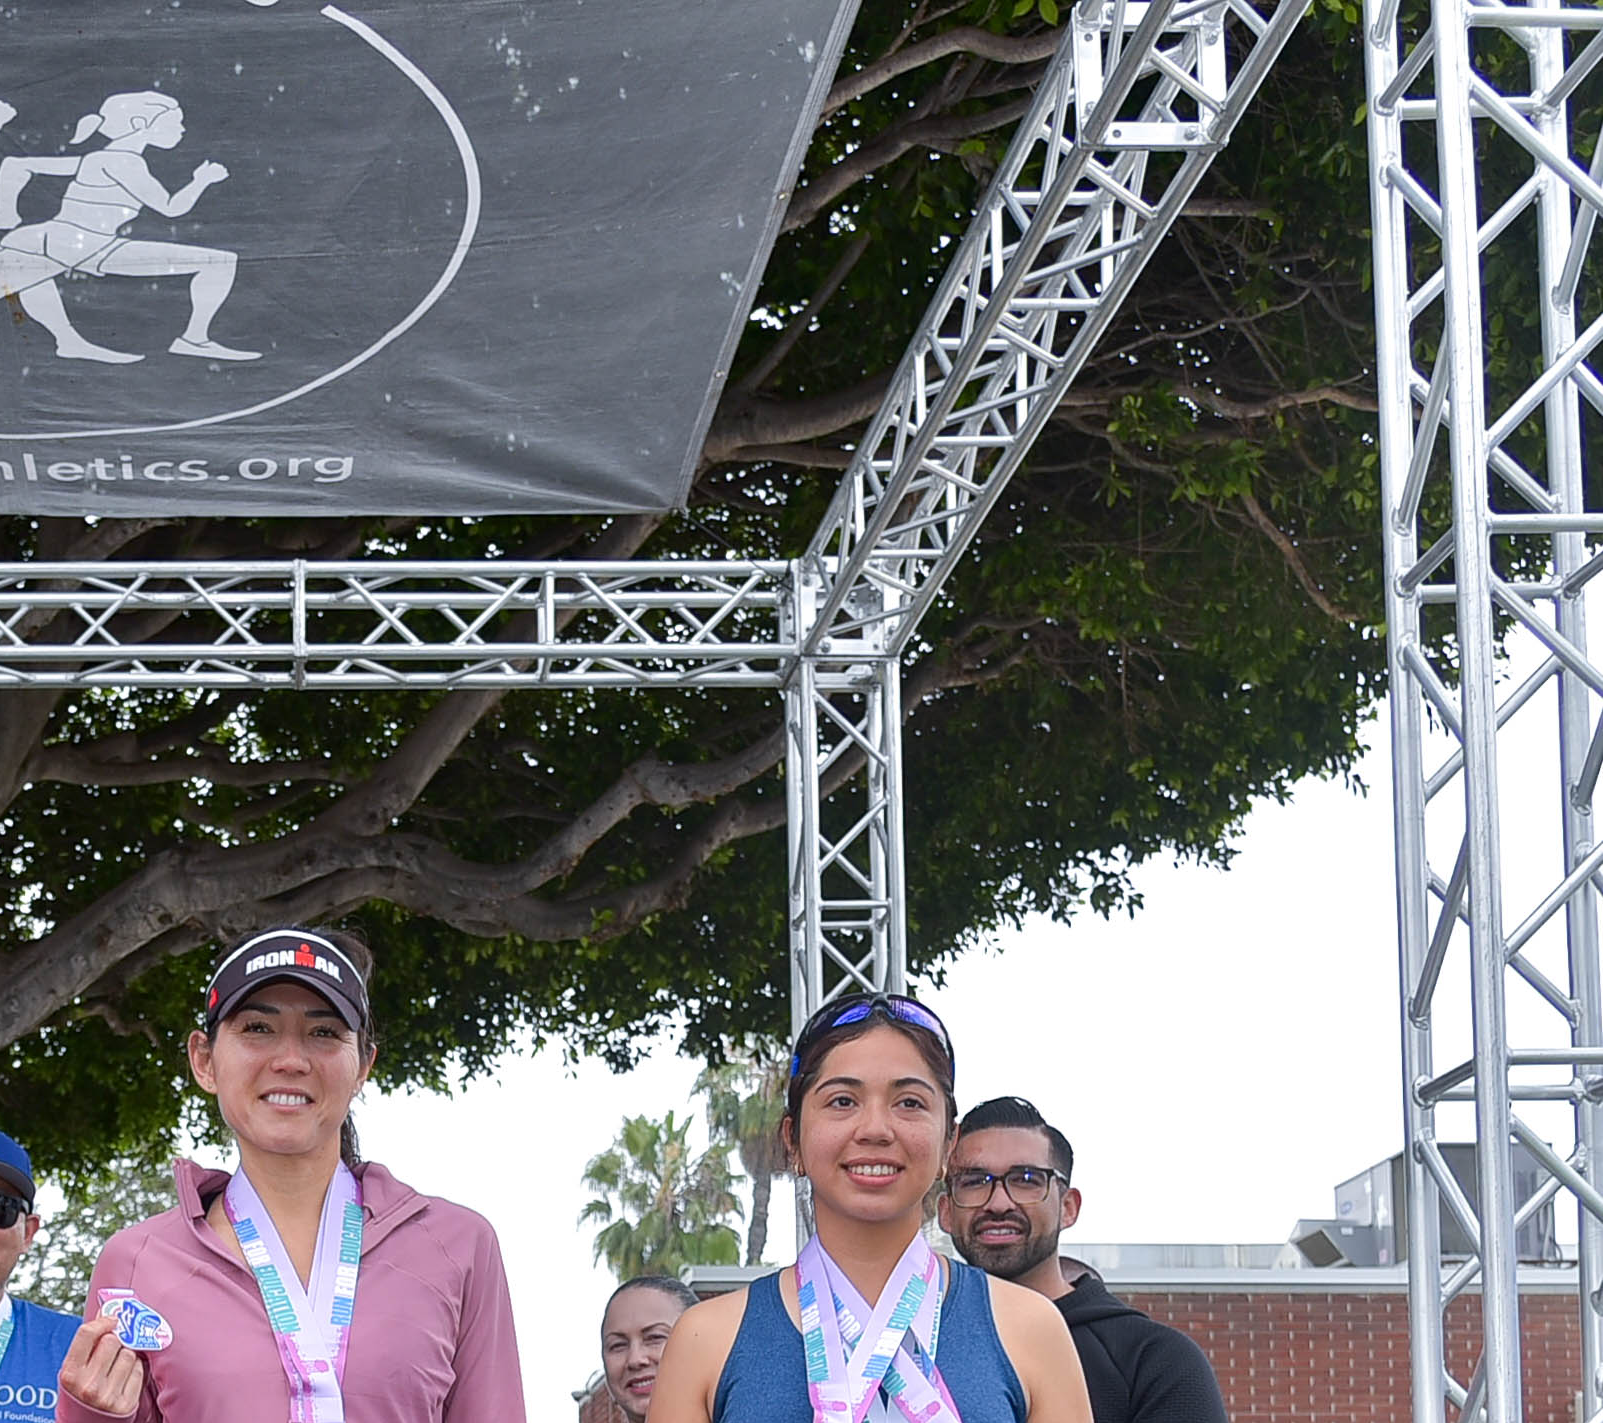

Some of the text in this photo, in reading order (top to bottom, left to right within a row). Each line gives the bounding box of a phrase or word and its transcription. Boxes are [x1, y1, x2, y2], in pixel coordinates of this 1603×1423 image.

[246, 944, 344, 983] IRONMAN
[340, 1201, 363, 1264] EDUCATION
[234, 1217, 300, 1333] RUN FOR EDUCATION
[330, 1296, 352, 1326] RUN
[861, 1354, 893, 1379] RUN
[886, 1273, 928, 1331] EDUCATION
